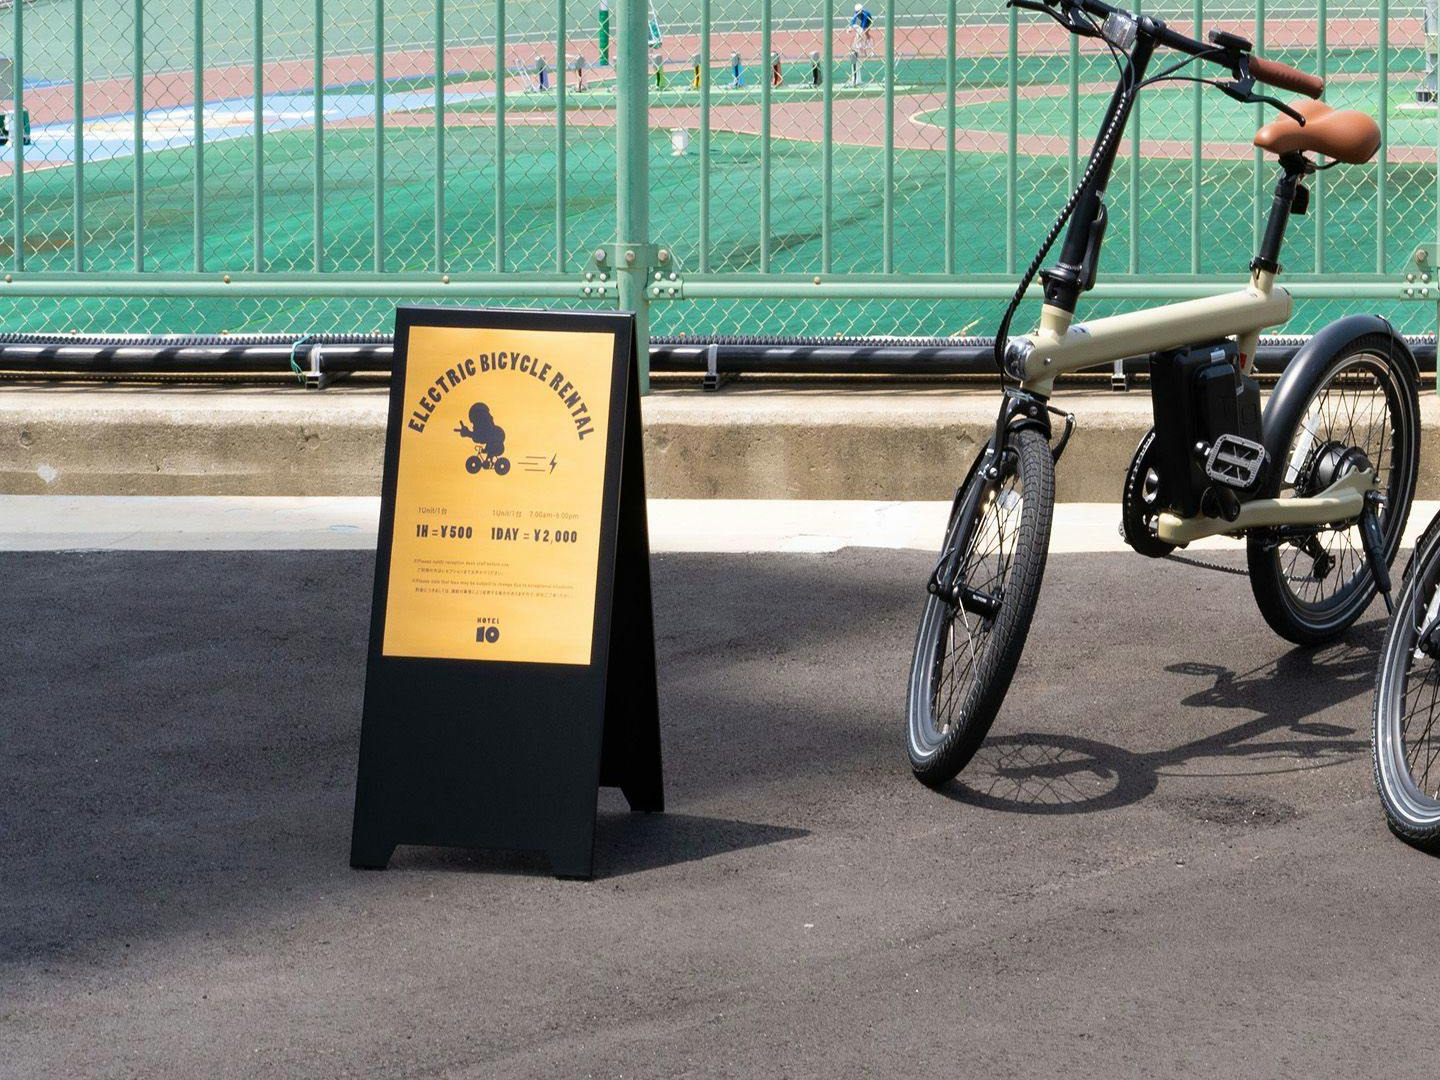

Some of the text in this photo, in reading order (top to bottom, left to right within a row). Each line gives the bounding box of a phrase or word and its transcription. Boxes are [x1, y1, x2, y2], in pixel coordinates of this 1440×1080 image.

[408, 352, 595, 440] ELECTRIC BICYCLE RENTAL
[416, 524, 429, 538] 1H
[441, 525, 473, 539] ¥500
[491, 527, 519, 541] 1DAY
[534, 529, 578, 544] ¥2,000
